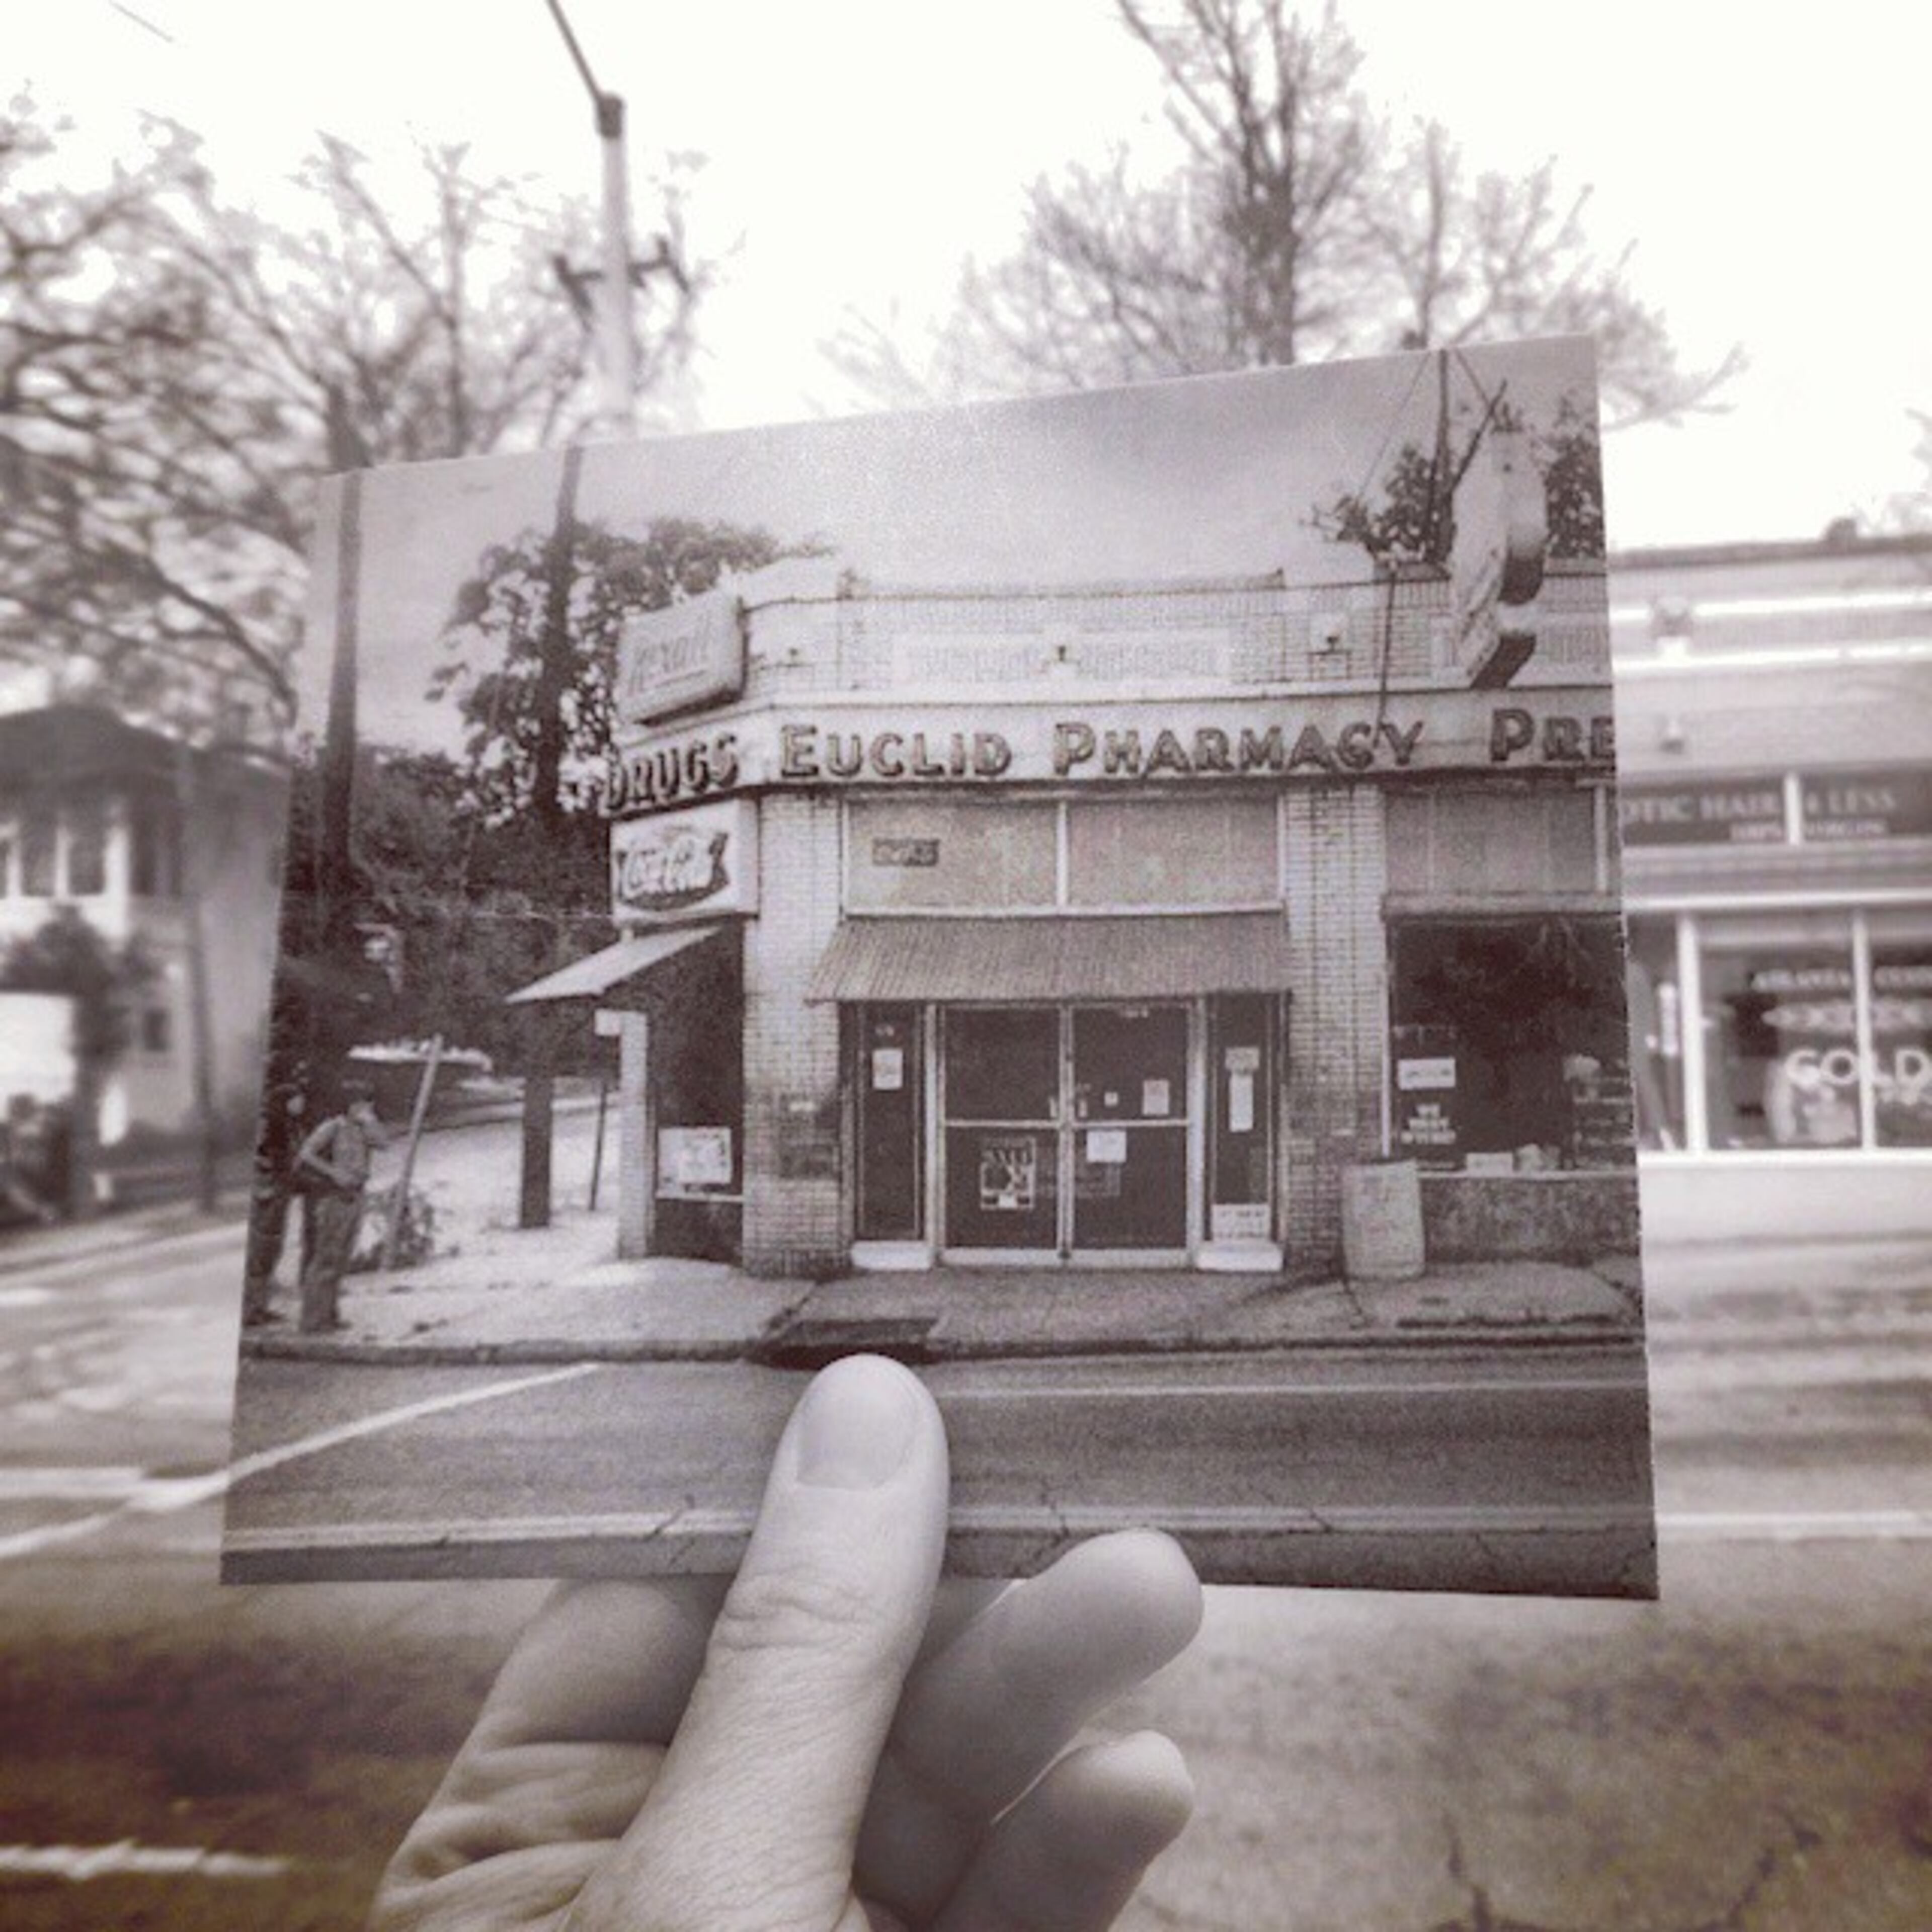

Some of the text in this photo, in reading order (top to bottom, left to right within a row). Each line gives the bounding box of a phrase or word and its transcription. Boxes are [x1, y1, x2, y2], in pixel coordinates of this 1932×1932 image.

[602, 733, 738, 812] DRUGS
[780, 708, 1615, 778] EUCLID PHARMACY PRE
